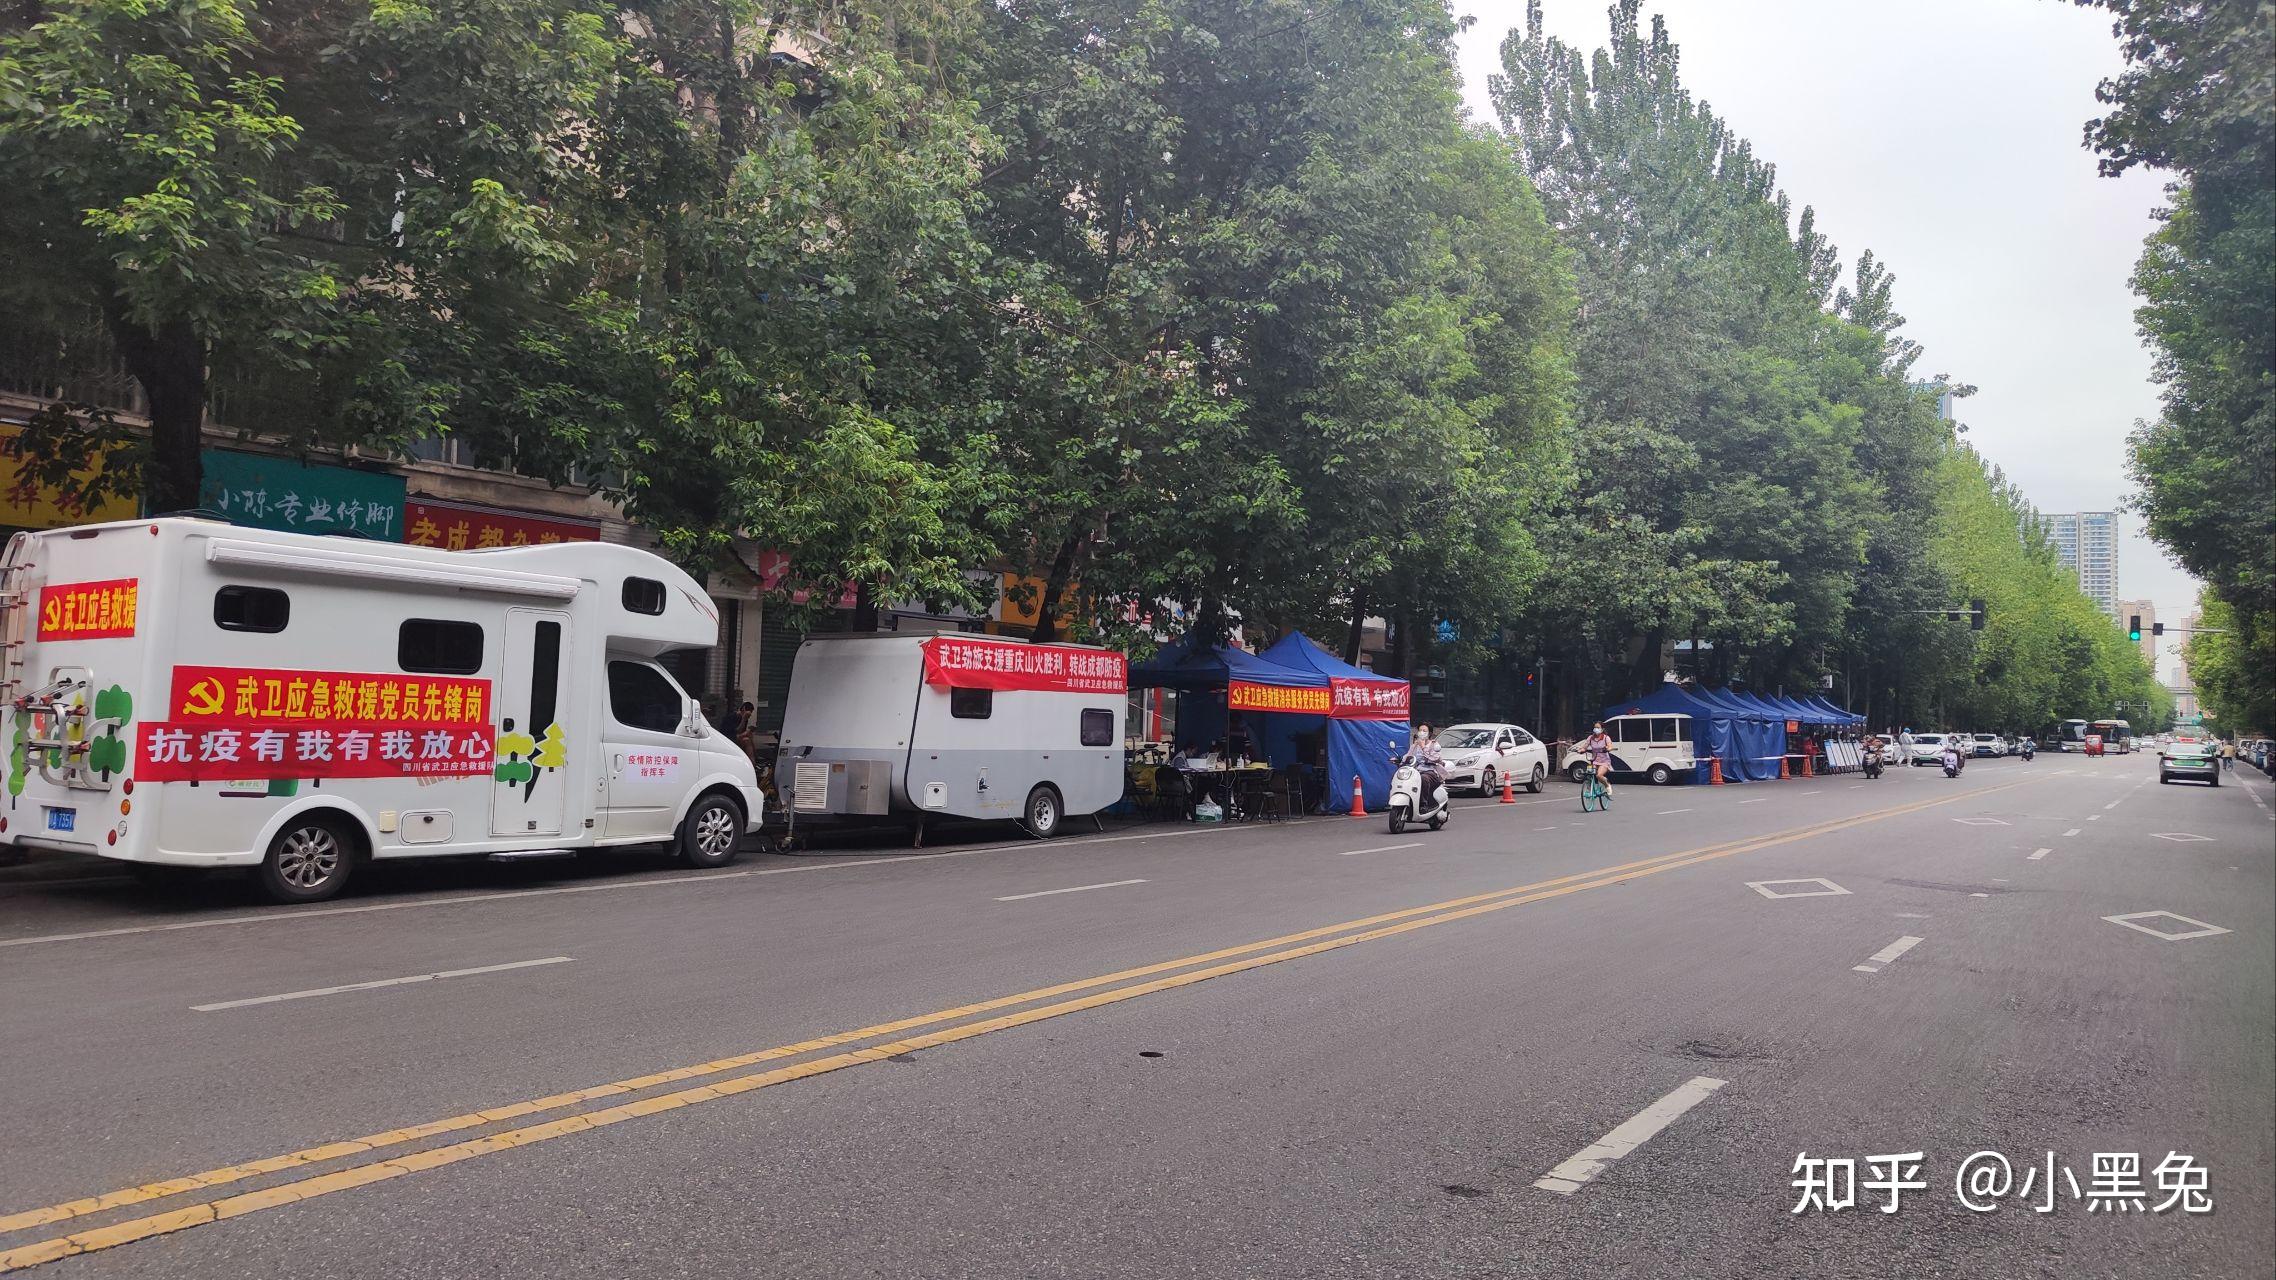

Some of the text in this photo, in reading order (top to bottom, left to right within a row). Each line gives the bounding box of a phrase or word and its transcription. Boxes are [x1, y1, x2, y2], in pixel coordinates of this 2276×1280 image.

[218, 488, 394, 536] 小陈专业修脚
[63, 586, 137, 632] 武卫应急救援
[235, 675, 482, 723] 武卫应急救援党员先锋岗
[147, 727, 491, 763] 抗疫有我有我放心
[628, 755, 678, 765] 疫情防控保障
[402, 761, 494, 772] 四川省武卫应急救援队
[641, 767, 666, 777] 指挥车
